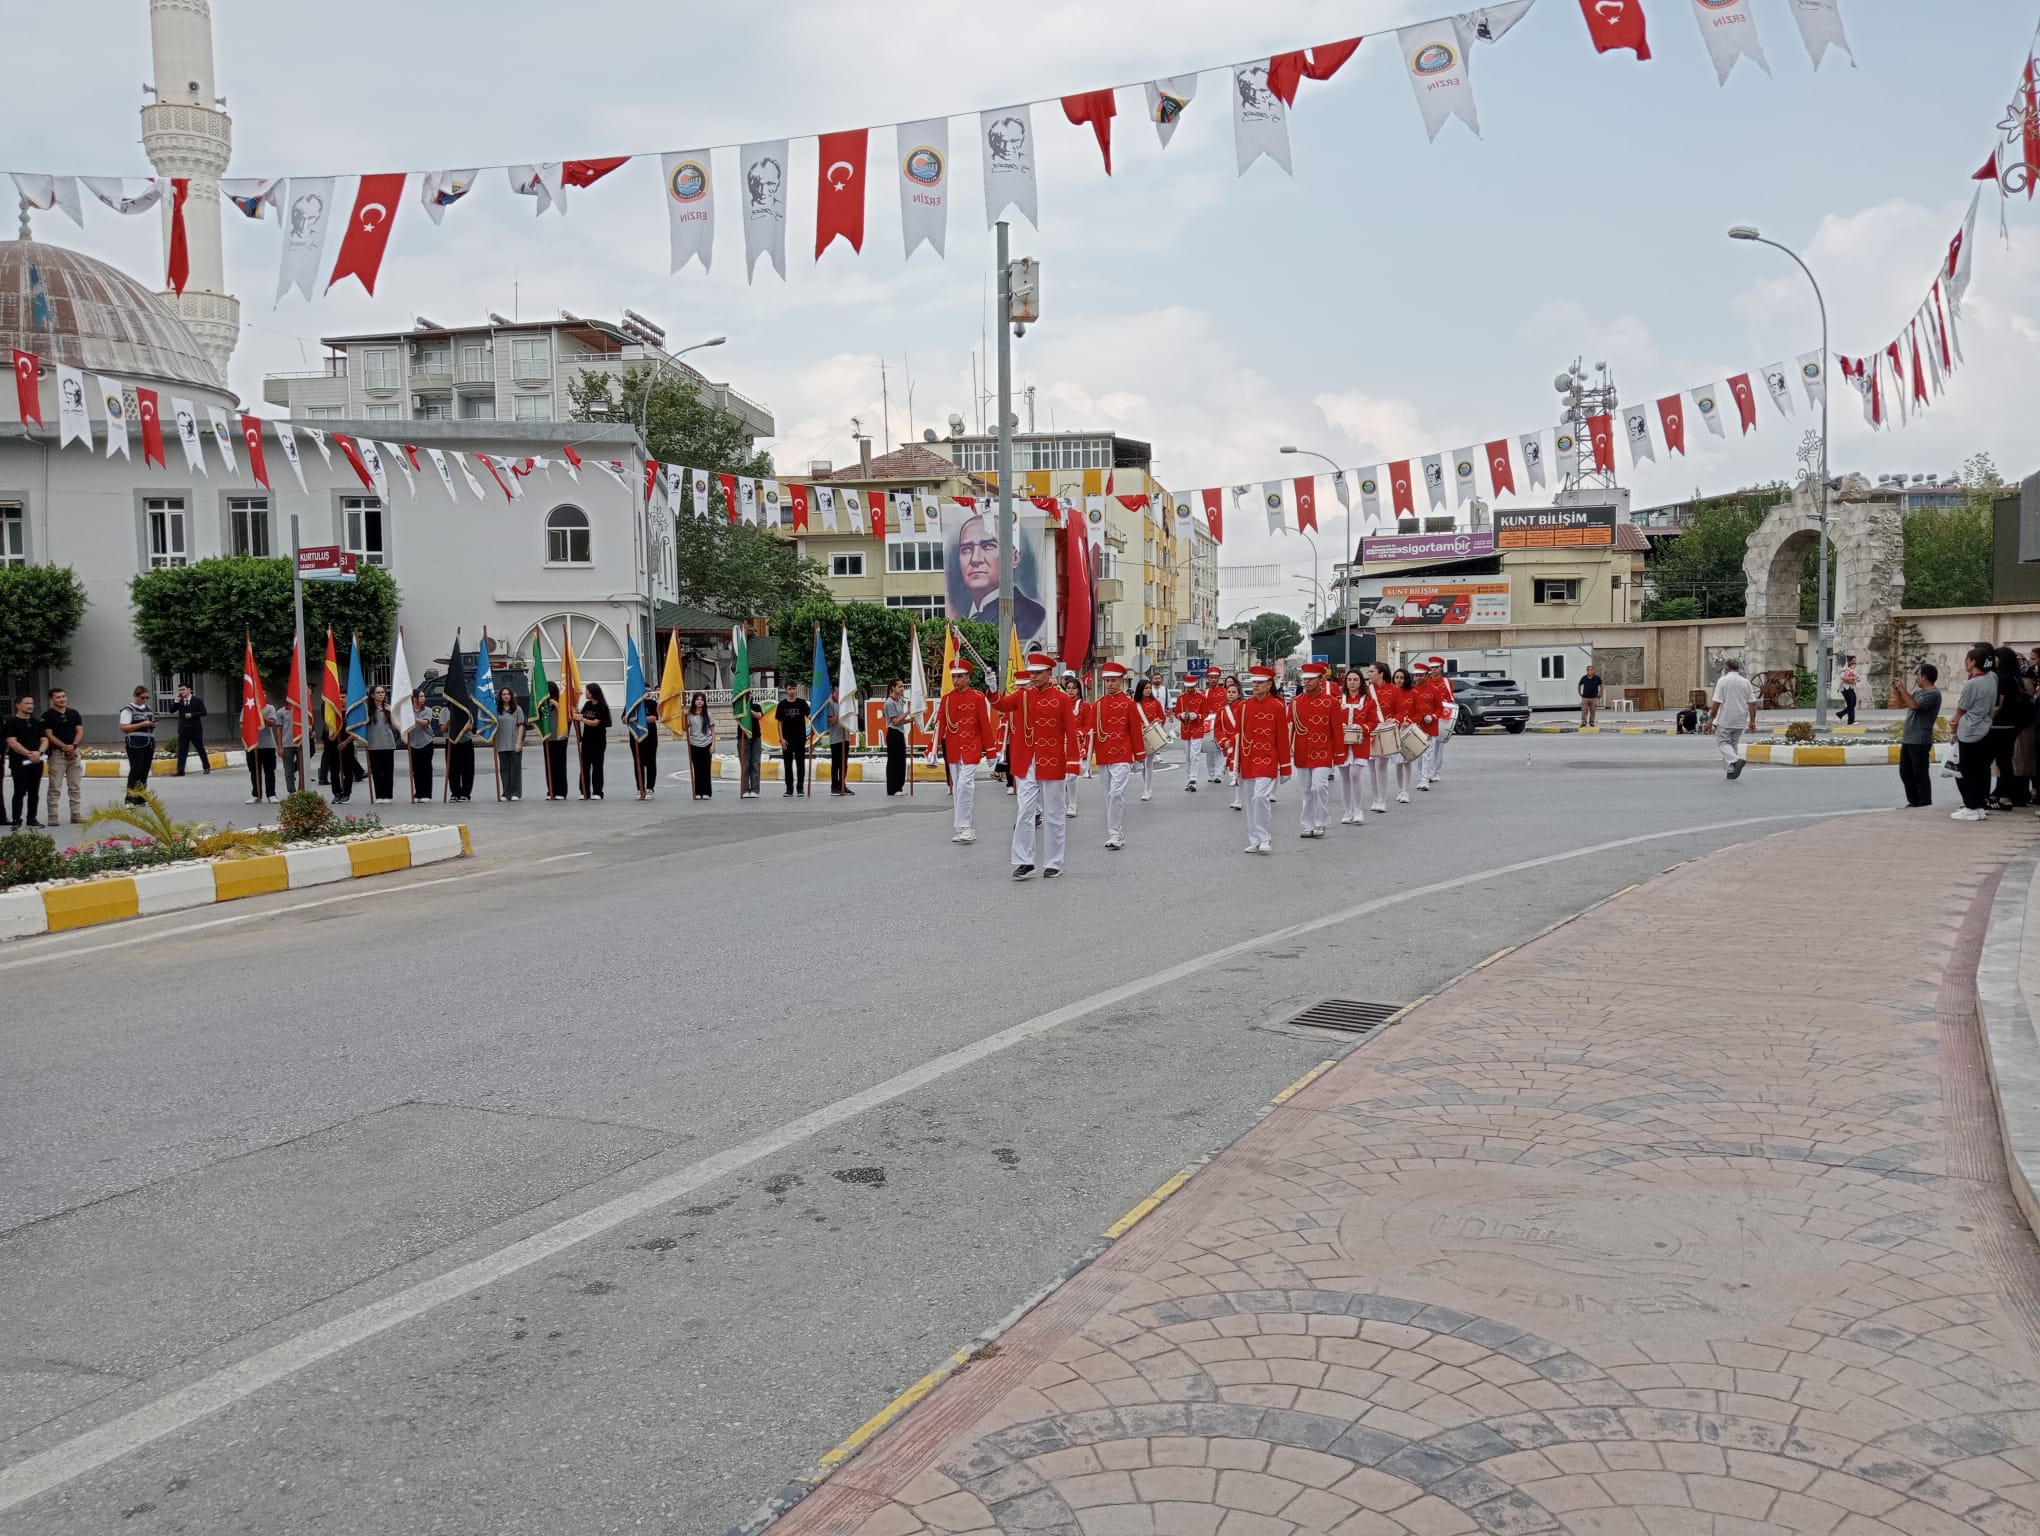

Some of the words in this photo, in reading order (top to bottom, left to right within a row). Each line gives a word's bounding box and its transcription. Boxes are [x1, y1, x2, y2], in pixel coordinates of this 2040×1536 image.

[1500, 515, 1536, 526] KUNT
[1538, 511, 1587, 526] BİLİŞİM
[1401, 538, 1470, 555] sigortambir
[299, 551, 330, 562] KURTULUŞ
[1387, 588, 1408, 596] KUNT
[1409, 587, 1439, 596] BİLİŞİM
